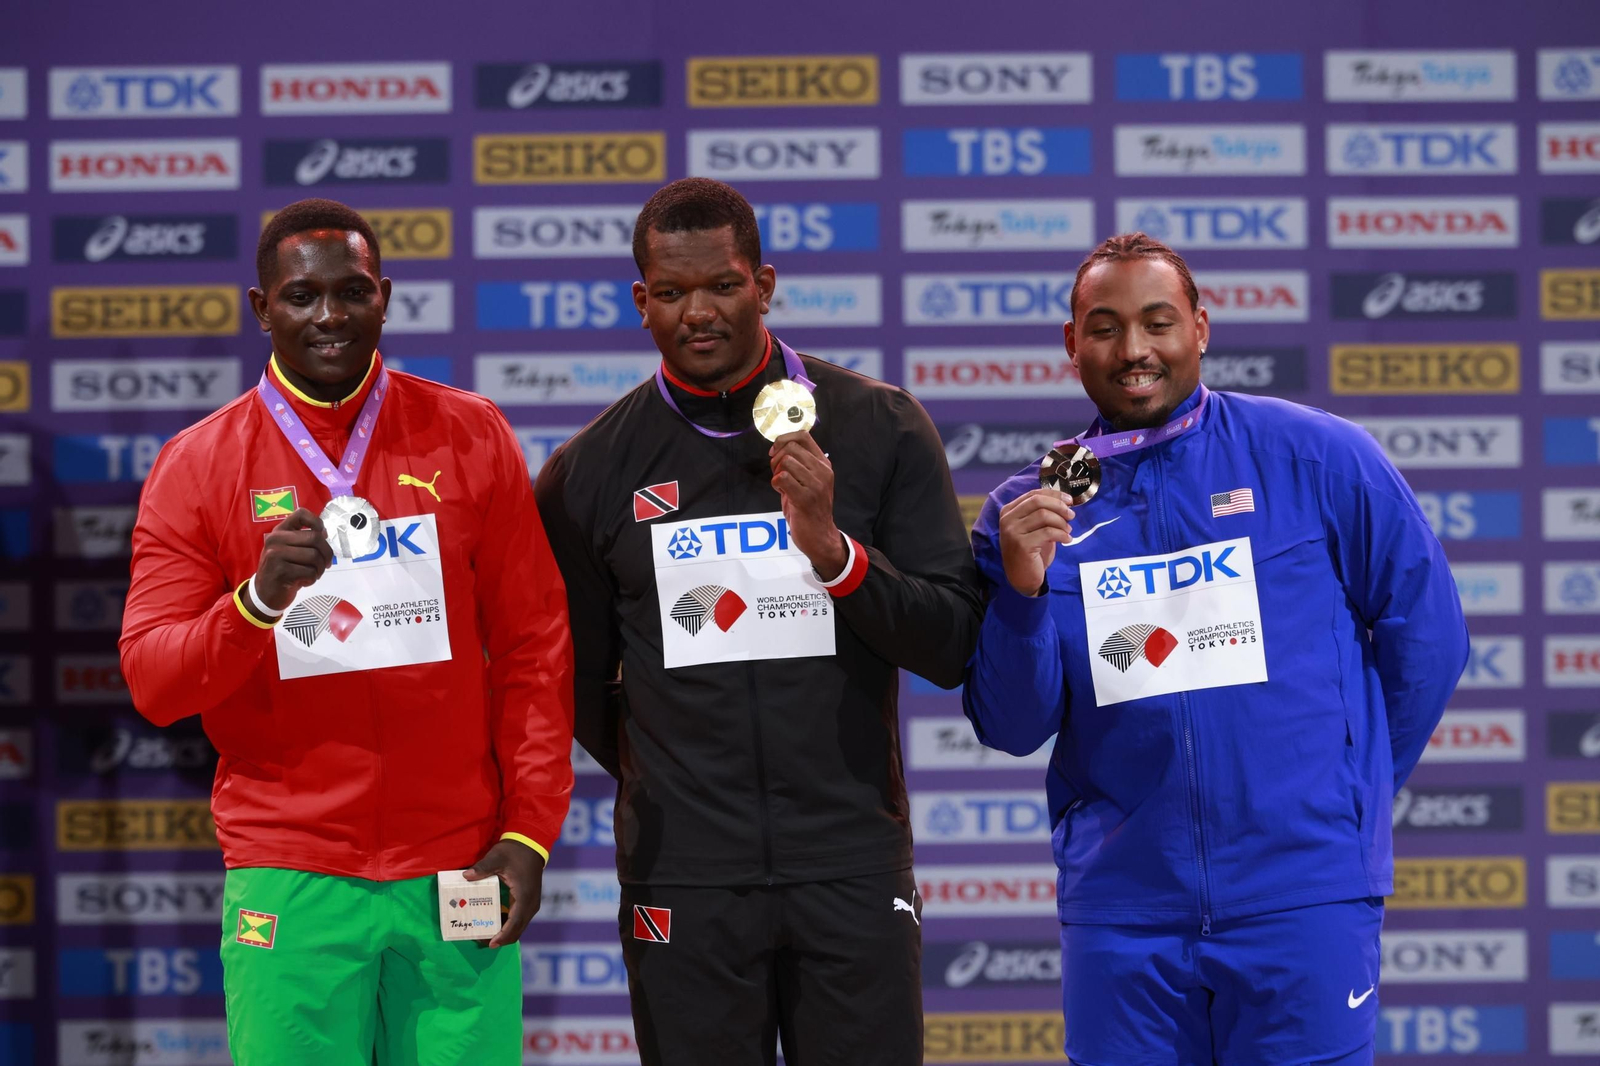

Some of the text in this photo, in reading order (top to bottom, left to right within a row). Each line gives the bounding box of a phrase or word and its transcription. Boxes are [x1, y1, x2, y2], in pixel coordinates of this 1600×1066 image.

[104, 74, 224, 108] TDK
[269, 76, 441, 102] HONDA
[546, 70, 629, 101] asics
[695, 61, 871, 100] SEIKO
[920, 64, 1068, 94] SONY
[1160, 55, 1258, 99] TBS
[335, 146, 417, 178] asics
[483, 139, 658, 178] SEIKO
[707, 139, 858, 169] SONY
[949, 129, 1047, 175] TBS
[1380, 131, 1498, 166] TDK
[58, 153, 230, 178] HONDA
[1170, 205, 1290, 241] TDK
[1337, 210, 1508, 235] HONDA
[123, 223, 205, 255] asics
[60, 291, 233, 332] SEIKO
[521, 281, 620, 328] TBS
[959, 280, 1073, 317] TDK
[1402, 280, 1484, 312] asics
[71, 369, 219, 401] SONY
[1338, 350, 1512, 389] SEIKO
[1129, 546, 1241, 594] TDK
[372, 599, 439, 612] WORLD ATHLETICS
[372, 606, 440, 620] CHAMPIONSHIPS
[756, 592, 827, 604] WORLD ATHLETICS
[757, 600, 828, 611] CHAMPIONSHIPS
[1187, 620, 1255, 637] WORLD ATHLETICS
[1187, 628, 1256, 644] CHAMPIONSHIPS
[1407, 794, 1490, 827] asics
[103, 952, 200, 996] TBS
[1382, 1006, 1480, 1052] TBS
